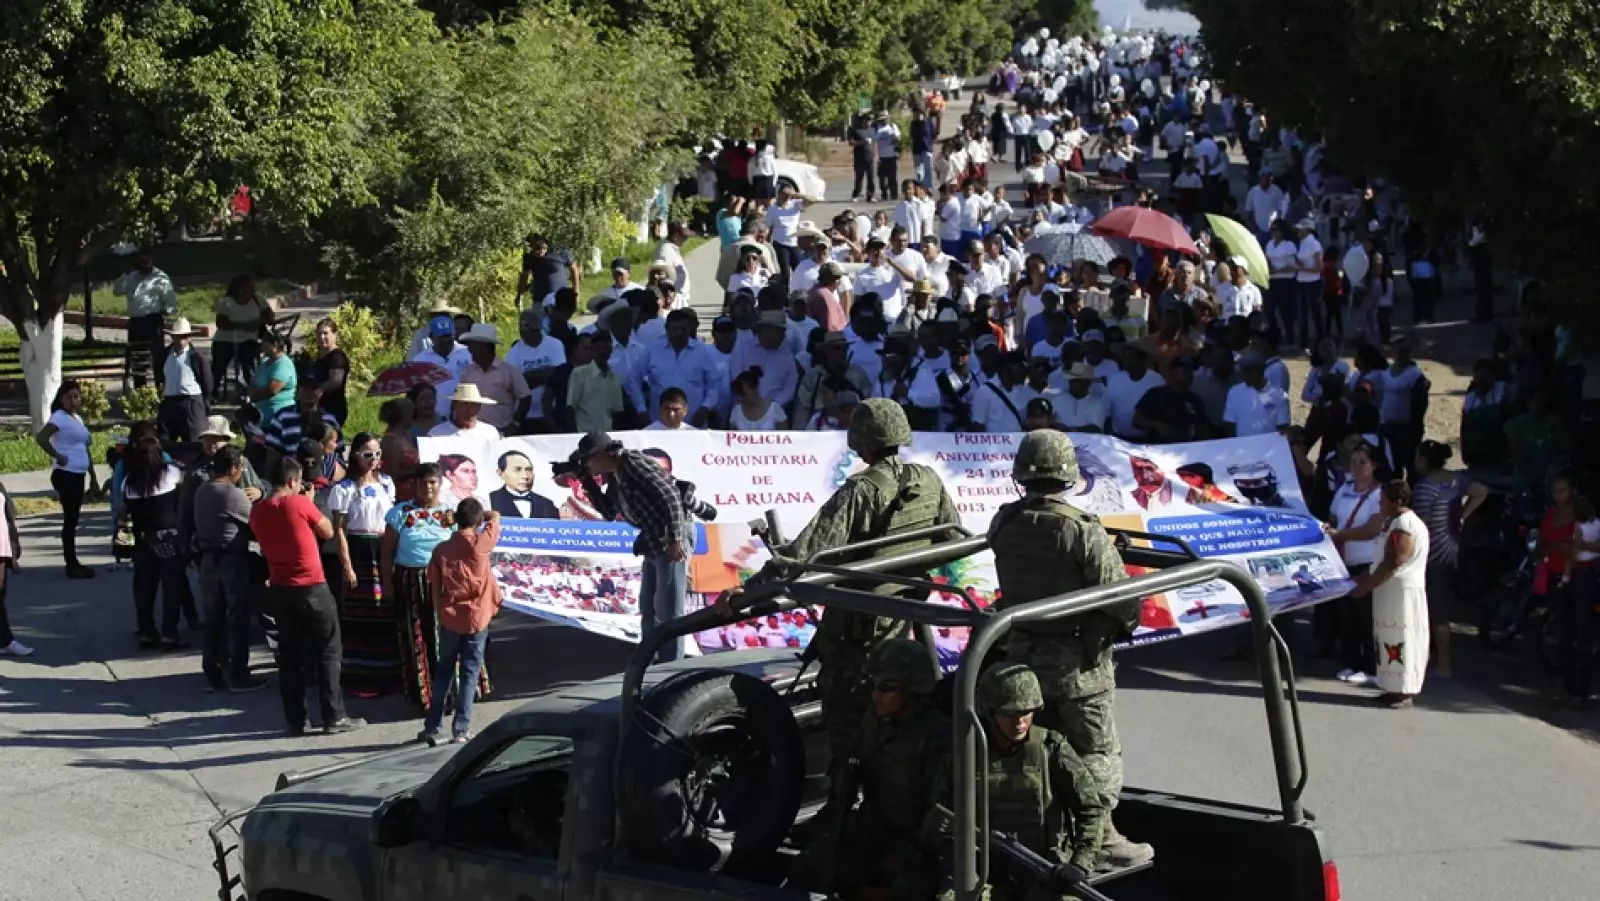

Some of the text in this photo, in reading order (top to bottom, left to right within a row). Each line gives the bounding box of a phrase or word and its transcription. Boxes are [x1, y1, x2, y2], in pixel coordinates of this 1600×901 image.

[726, 432, 792, 447] POLICIA
[954, 432, 1013, 445] PRIMER
[702, 453, 818, 466] COMUNITARIA
[935, 451, 1016, 462] ANIVERSAR
[965, 468, 1011, 478] 24 DE
[752, 475, 773, 485] DE
[715, 491, 815, 506] LA RUANA
[957, 502, 985, 513] 013
[1154, 522, 1199, 532] UNIDOS
[1203, 518, 1244, 529] SOMOS
[559, 528, 582, 536] QUE
[1200, 531, 1224, 541] QUE
